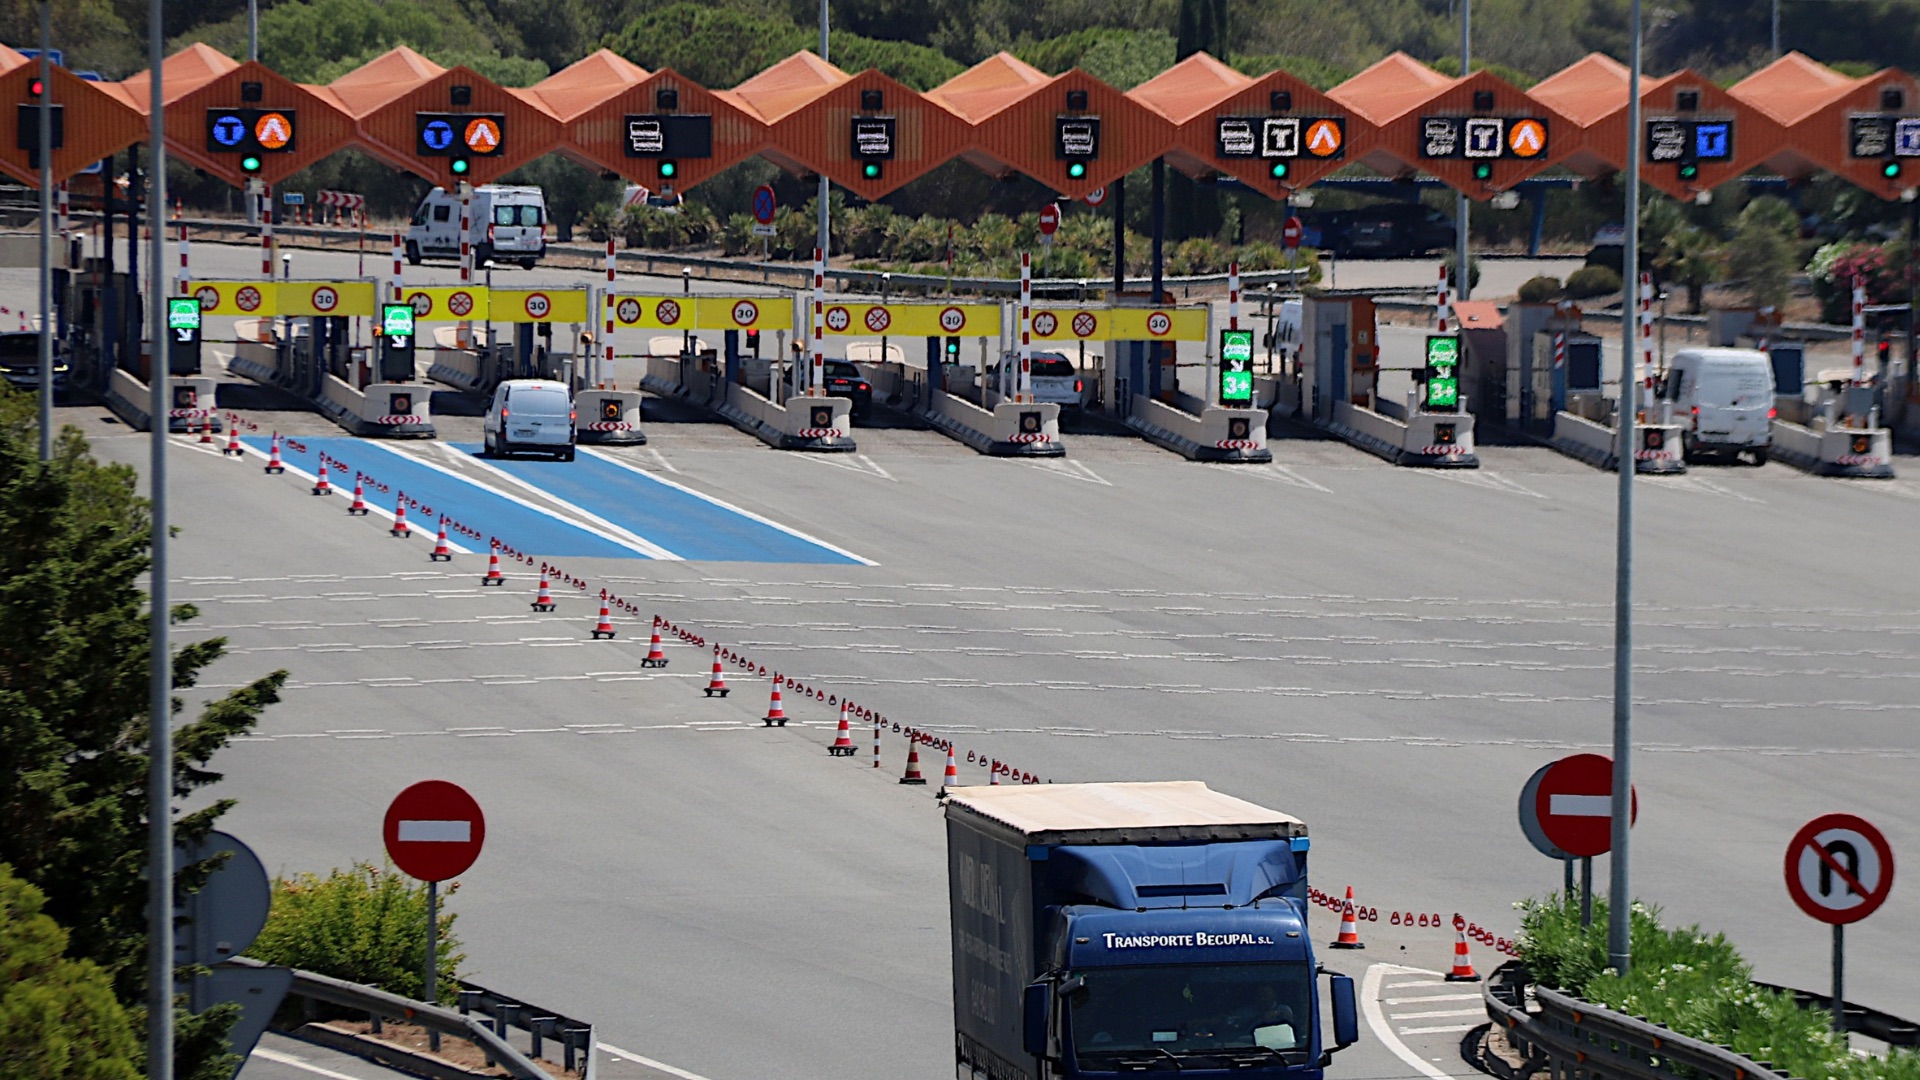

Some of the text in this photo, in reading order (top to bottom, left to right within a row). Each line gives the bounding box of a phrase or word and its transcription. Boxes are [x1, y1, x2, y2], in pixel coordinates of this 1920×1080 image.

[317, 295, 332, 304] 30
[530, 301, 545, 310] 30
[737, 309, 753, 318] 30
[945, 315, 960, 325] 30
[1151, 319, 1166, 328] 30
[1225, 376, 1249, 395] 3+
[1431, 383, 1455, 400] 3+
[1103, 932, 1194, 949] TRANSPORTE
[1196, 932, 1256, 946] BECUPAL
